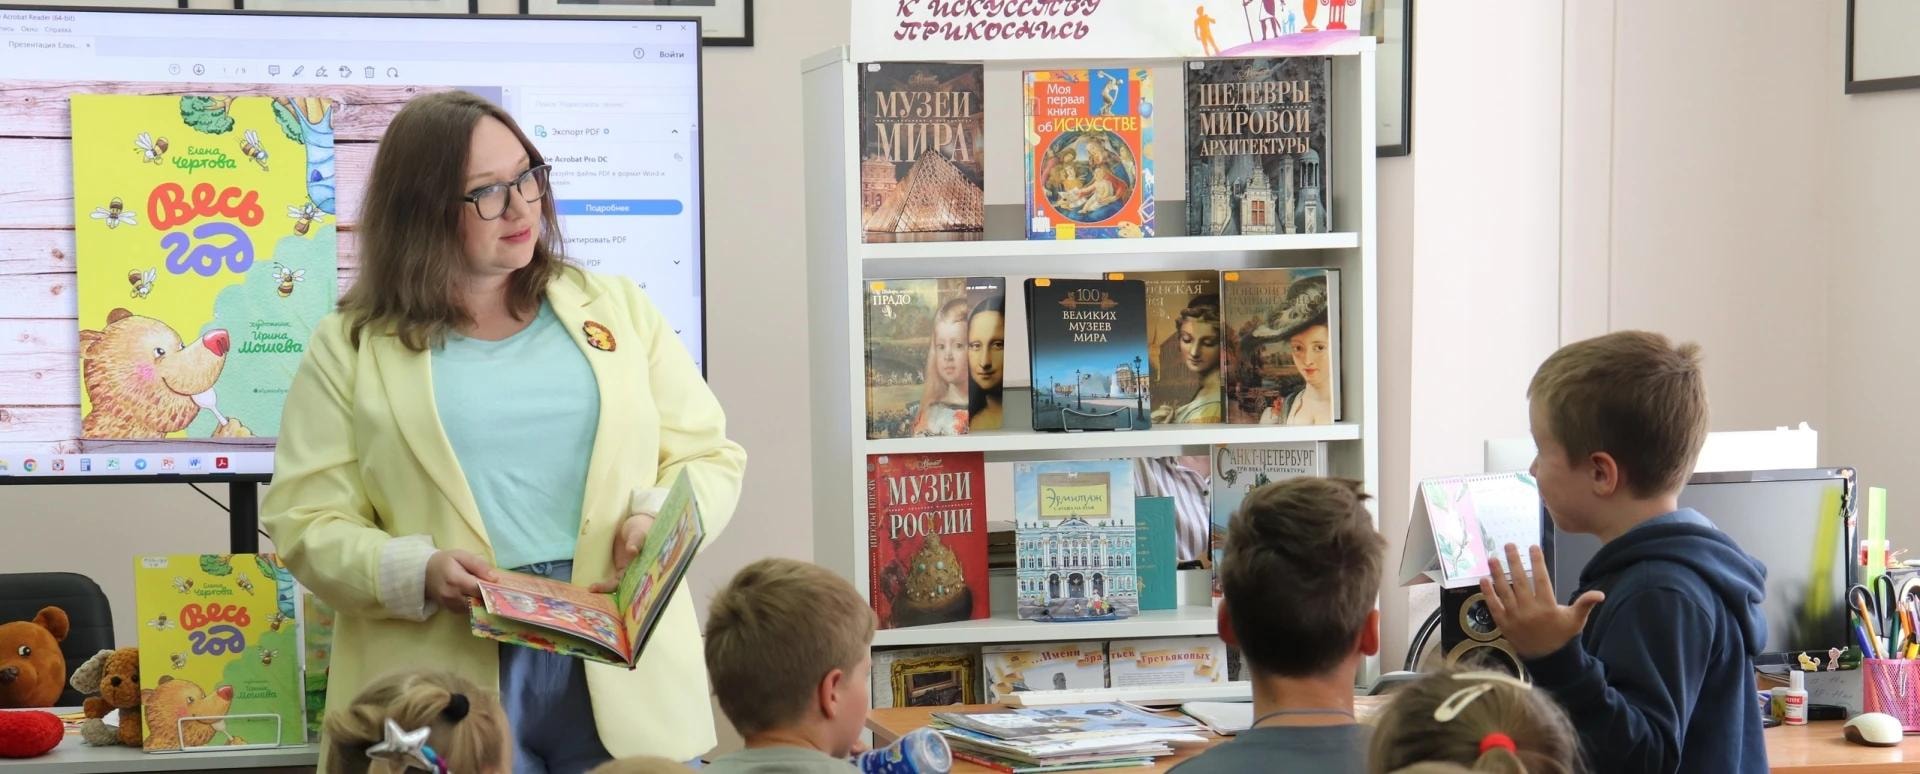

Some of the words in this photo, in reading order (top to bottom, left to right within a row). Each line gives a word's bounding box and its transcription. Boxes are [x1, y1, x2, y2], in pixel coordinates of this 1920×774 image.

[1046, 83, 1072, 95] Моя
[1199, 80, 1312, 110] ШЕДЕВРЫ
[874, 90, 973, 119] МУЗЕИ
[1046, 96, 1086, 107] первая
[1046, 107, 1078, 117] книга
[1037, 121, 1053, 132] об
[1053, 116, 1138, 132] ИСКУССТВЕ
[1199, 106, 1312, 136] МИРОВОЙ
[551, 127, 583, 137] Экспорт
[585, 127, 600, 136] PDF
[874, 121, 976, 163] МИРА
[1199, 137, 1311, 157] АРХИТЕКТУРЫ
[187, 146, 221, 156] Елена
[554, 155, 582, 164] Acrobat
[584, 155, 596, 164] Pro
[597, 155, 608, 164] DC
[147, 182, 265, 231] Весь
[585, 203, 630, 213] Подробнее
[612, 235, 627, 244] PDF
[160, 221, 255, 278] год
[872, 294, 912, 305] ПРАДО
[1076, 288, 1100, 302] 100
[1063, 310, 1118, 321] ВЕЛИКИХ
[1068, 321, 1112, 332] МУЗЕЕВ
[251, 331, 289, 342] Ирина
[1074, 333, 1108, 343] МИРА
[238, 339, 304, 354] Мошева
[1216, 448, 1315, 482] САНКТ-ПЕТЕРБУРГ
[888, 471, 973, 506] МУЗЕИ
[889, 508, 973, 540] РОССИИ
[180, 602, 251, 631] Весь
[188, 624, 246, 657] год
